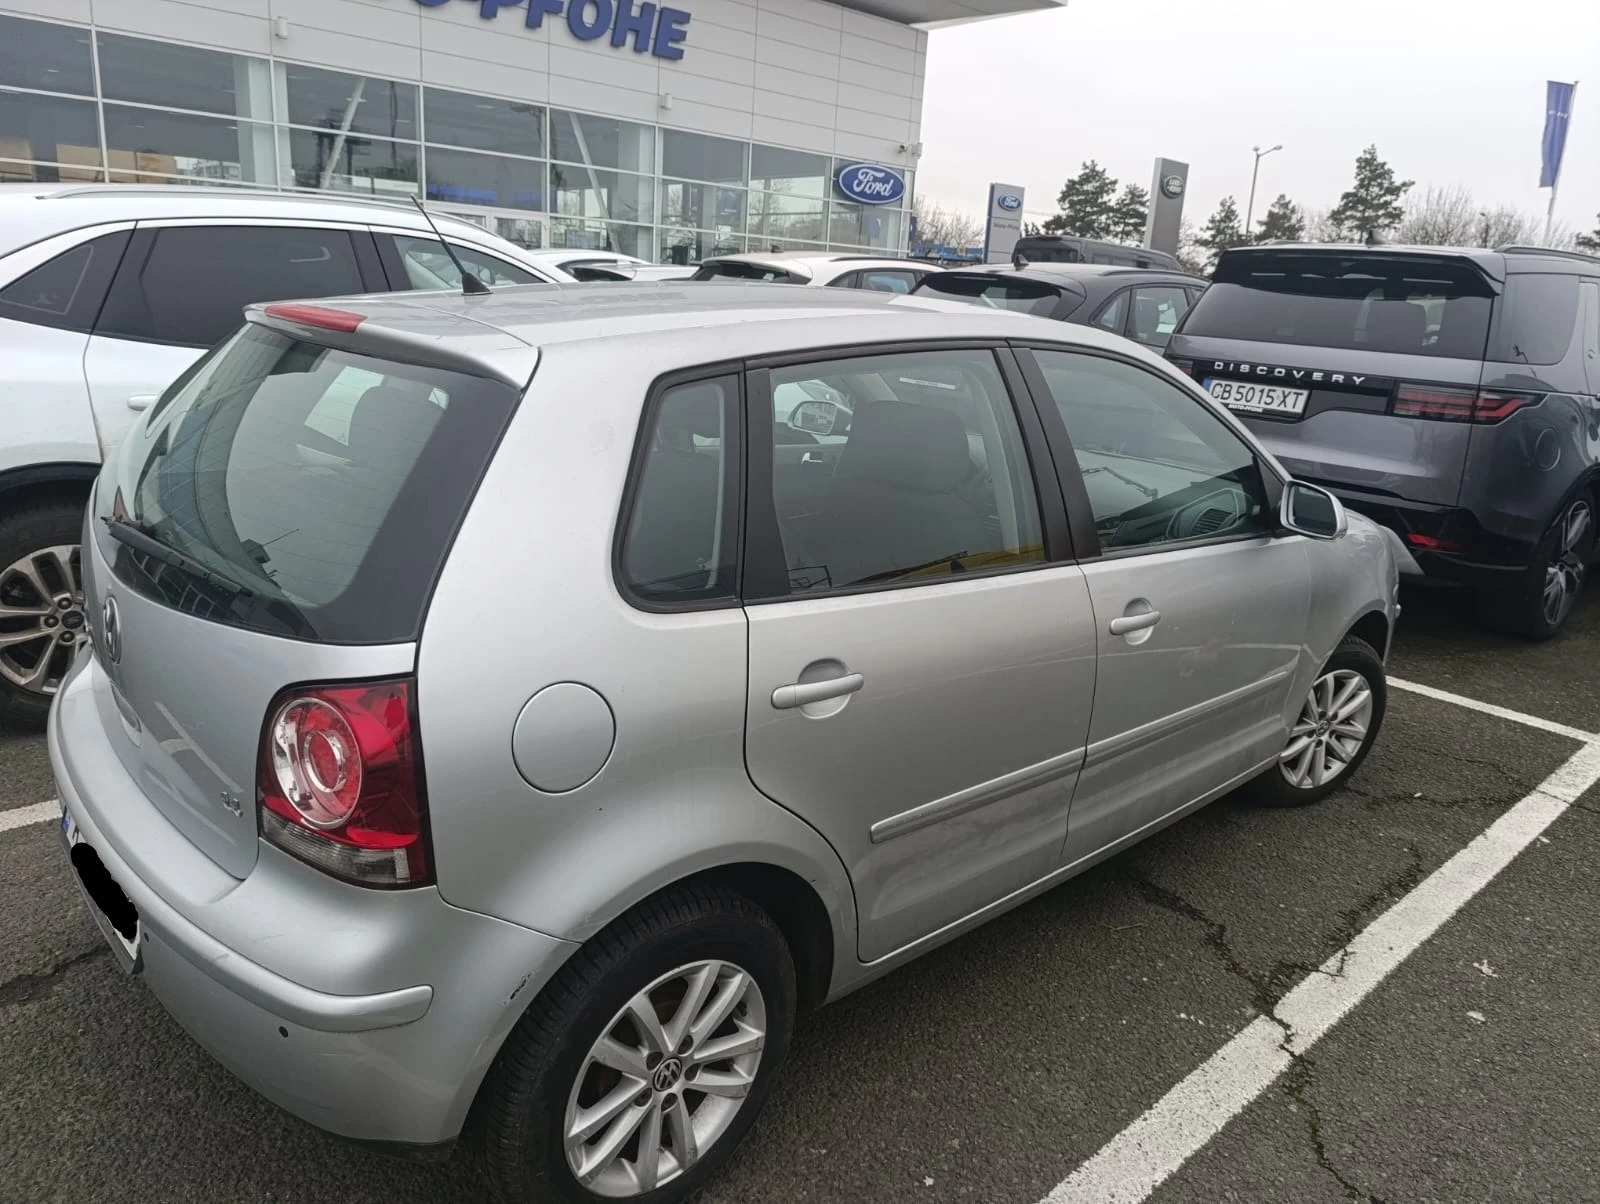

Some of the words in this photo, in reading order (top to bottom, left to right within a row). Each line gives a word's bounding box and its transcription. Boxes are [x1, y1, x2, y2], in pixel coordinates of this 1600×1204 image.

[413, 0, 692, 60] FOHE
[853, 168, 894, 197] Ford
[1214, 361, 1365, 385] DISCOVERY
[1211, 382, 1233, 401] CB
[1233, 385, 1277, 406] 5015
[1277, 390, 1304, 409] XT
